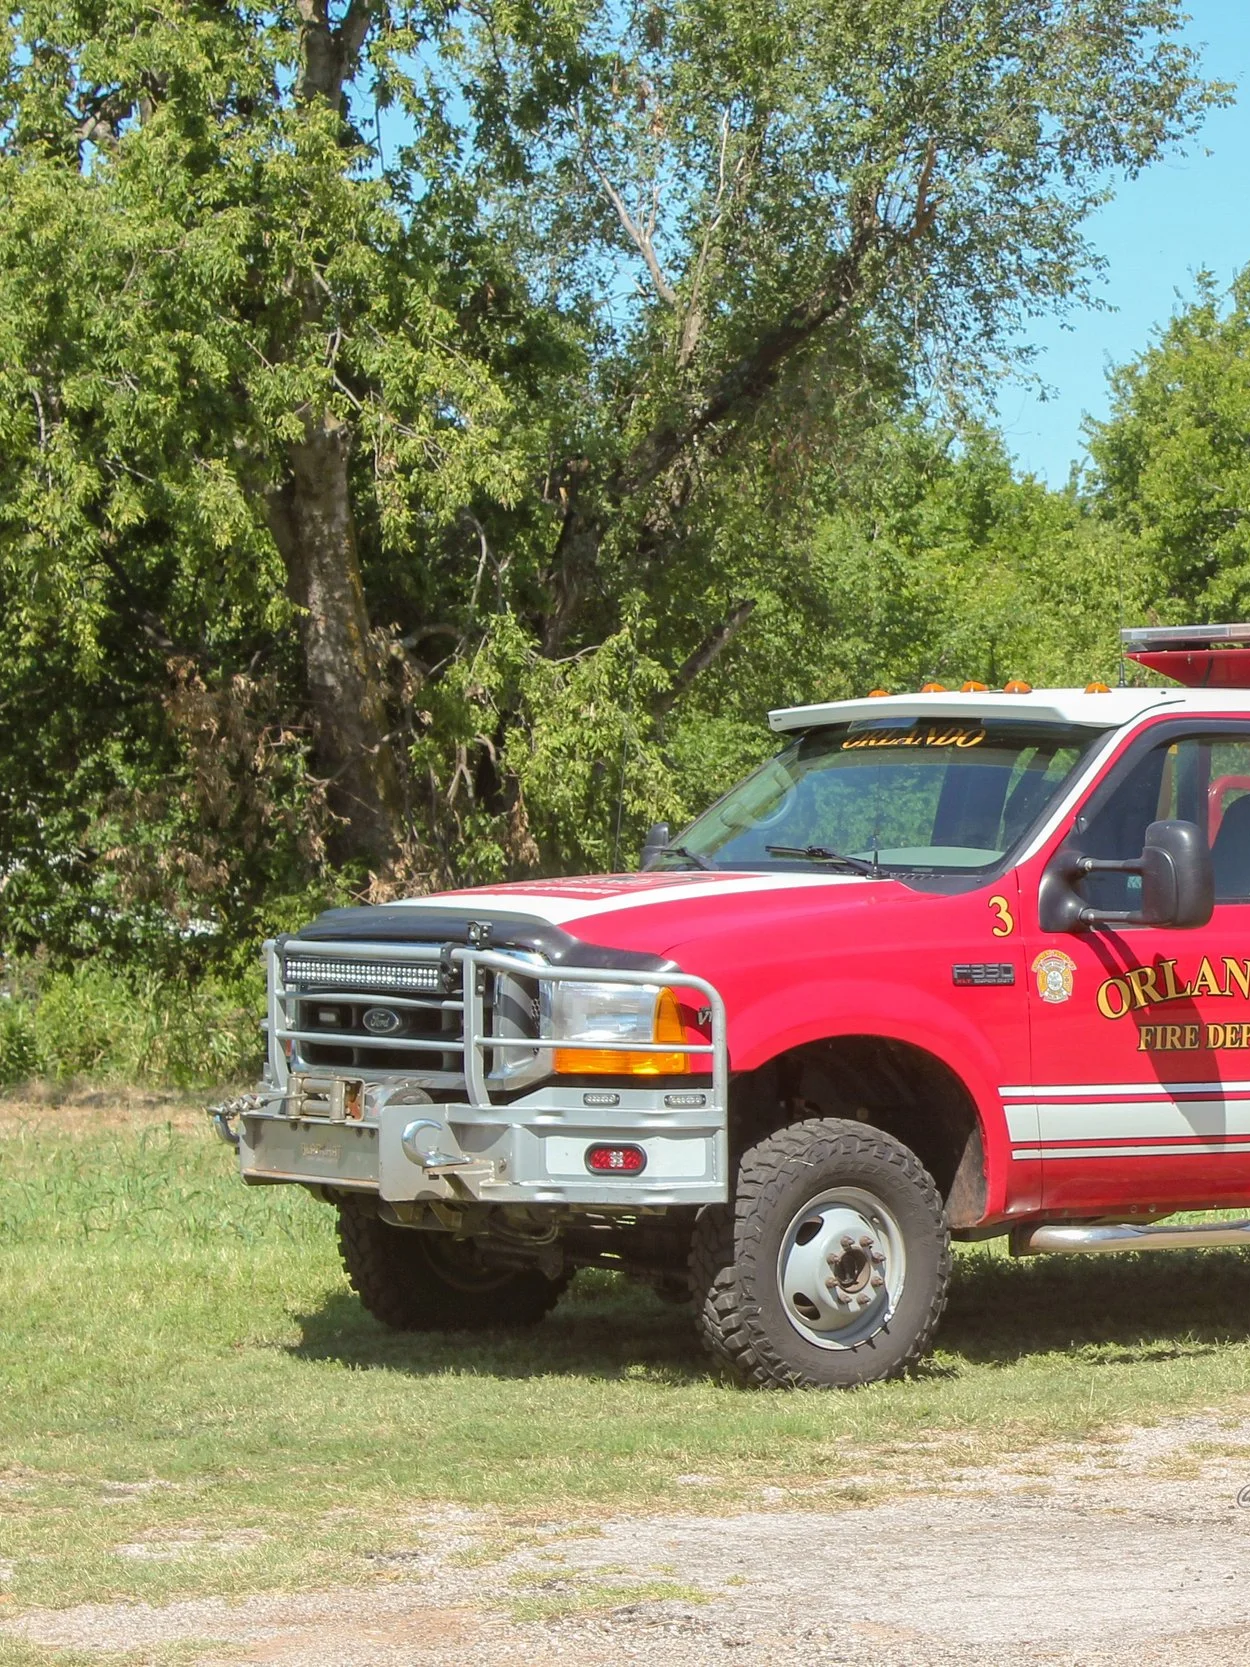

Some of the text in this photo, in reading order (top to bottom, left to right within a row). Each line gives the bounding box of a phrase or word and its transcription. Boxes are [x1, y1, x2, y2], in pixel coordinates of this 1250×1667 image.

[840, 727, 987, 749] ORLANDO
[988, 895, 1015, 937] 3
[1137, 1024, 1201, 1051] FIRE
